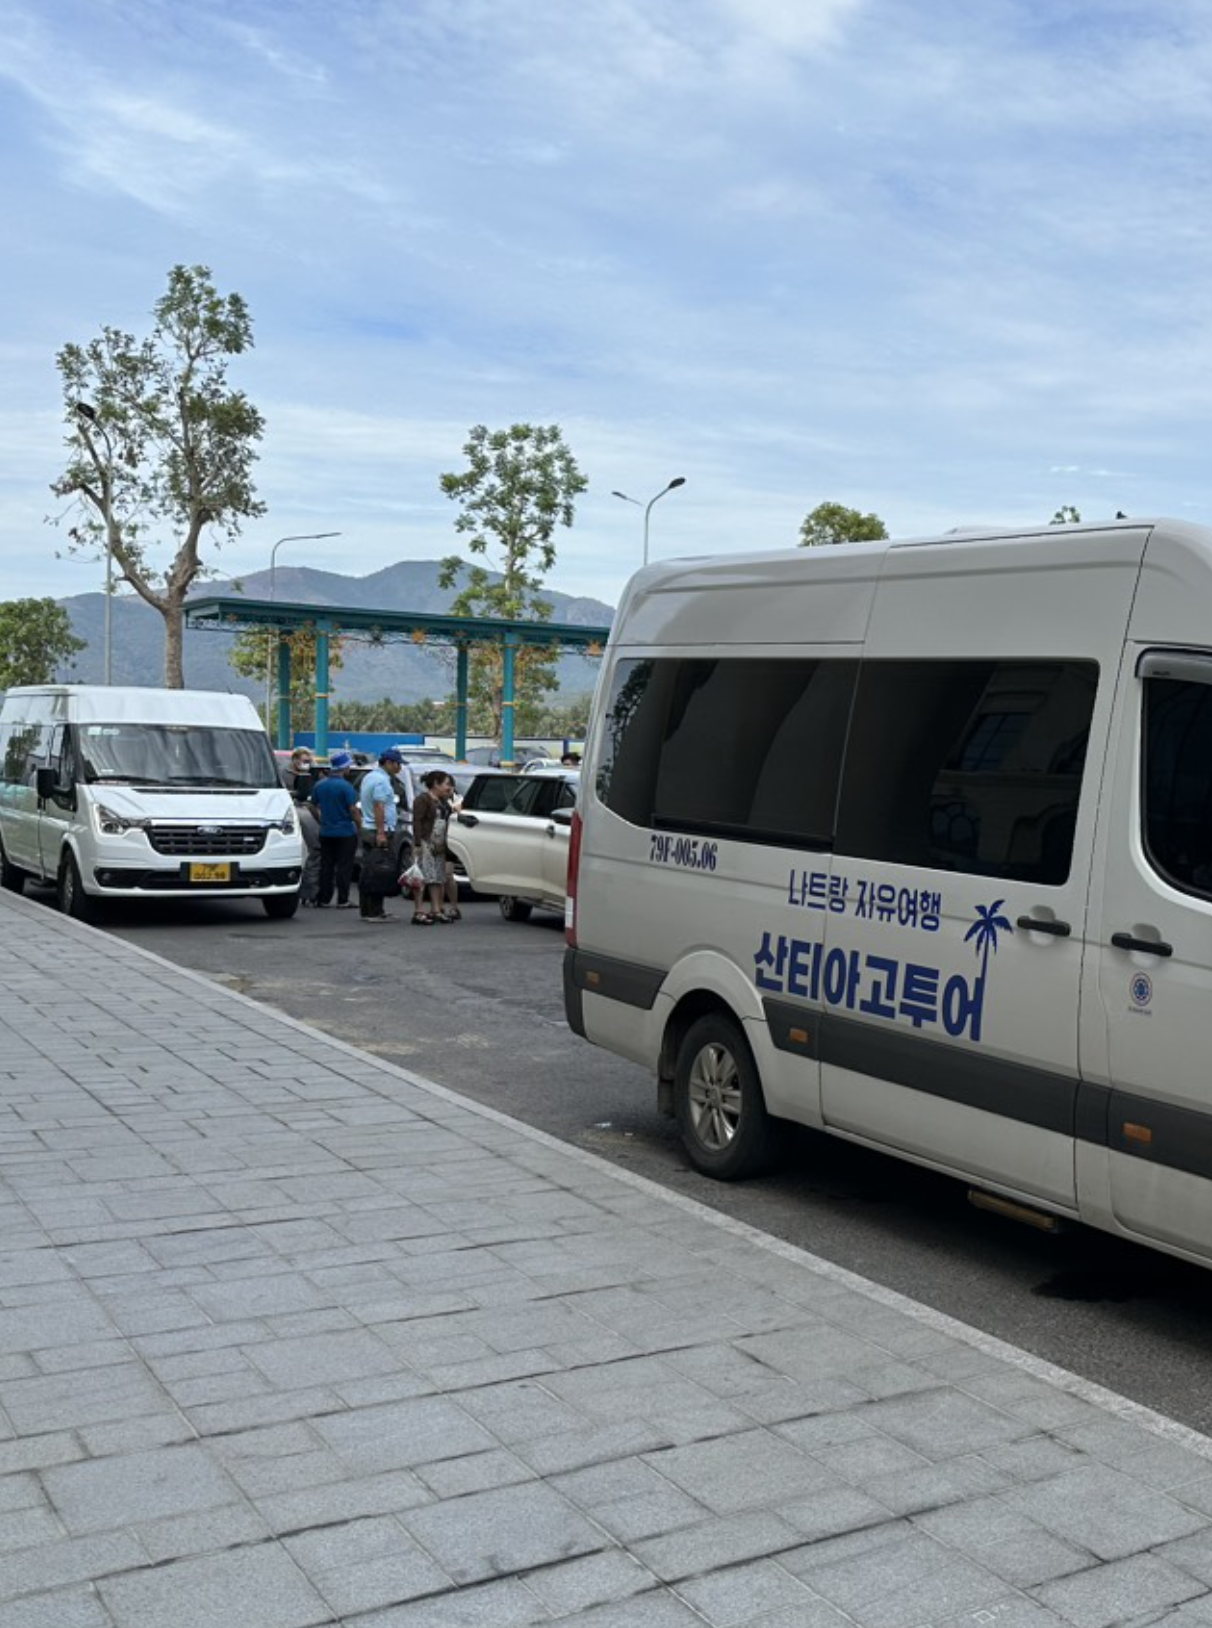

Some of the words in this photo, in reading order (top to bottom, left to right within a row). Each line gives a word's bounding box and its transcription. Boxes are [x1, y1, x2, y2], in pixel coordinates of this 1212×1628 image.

[650, 834, 718, 872] 79F-005.06
[788, 869, 849, 914] 나트랑
[854, 880, 942, 932] 자유여행
[754, 931, 984, 1041] 산티아고투어
